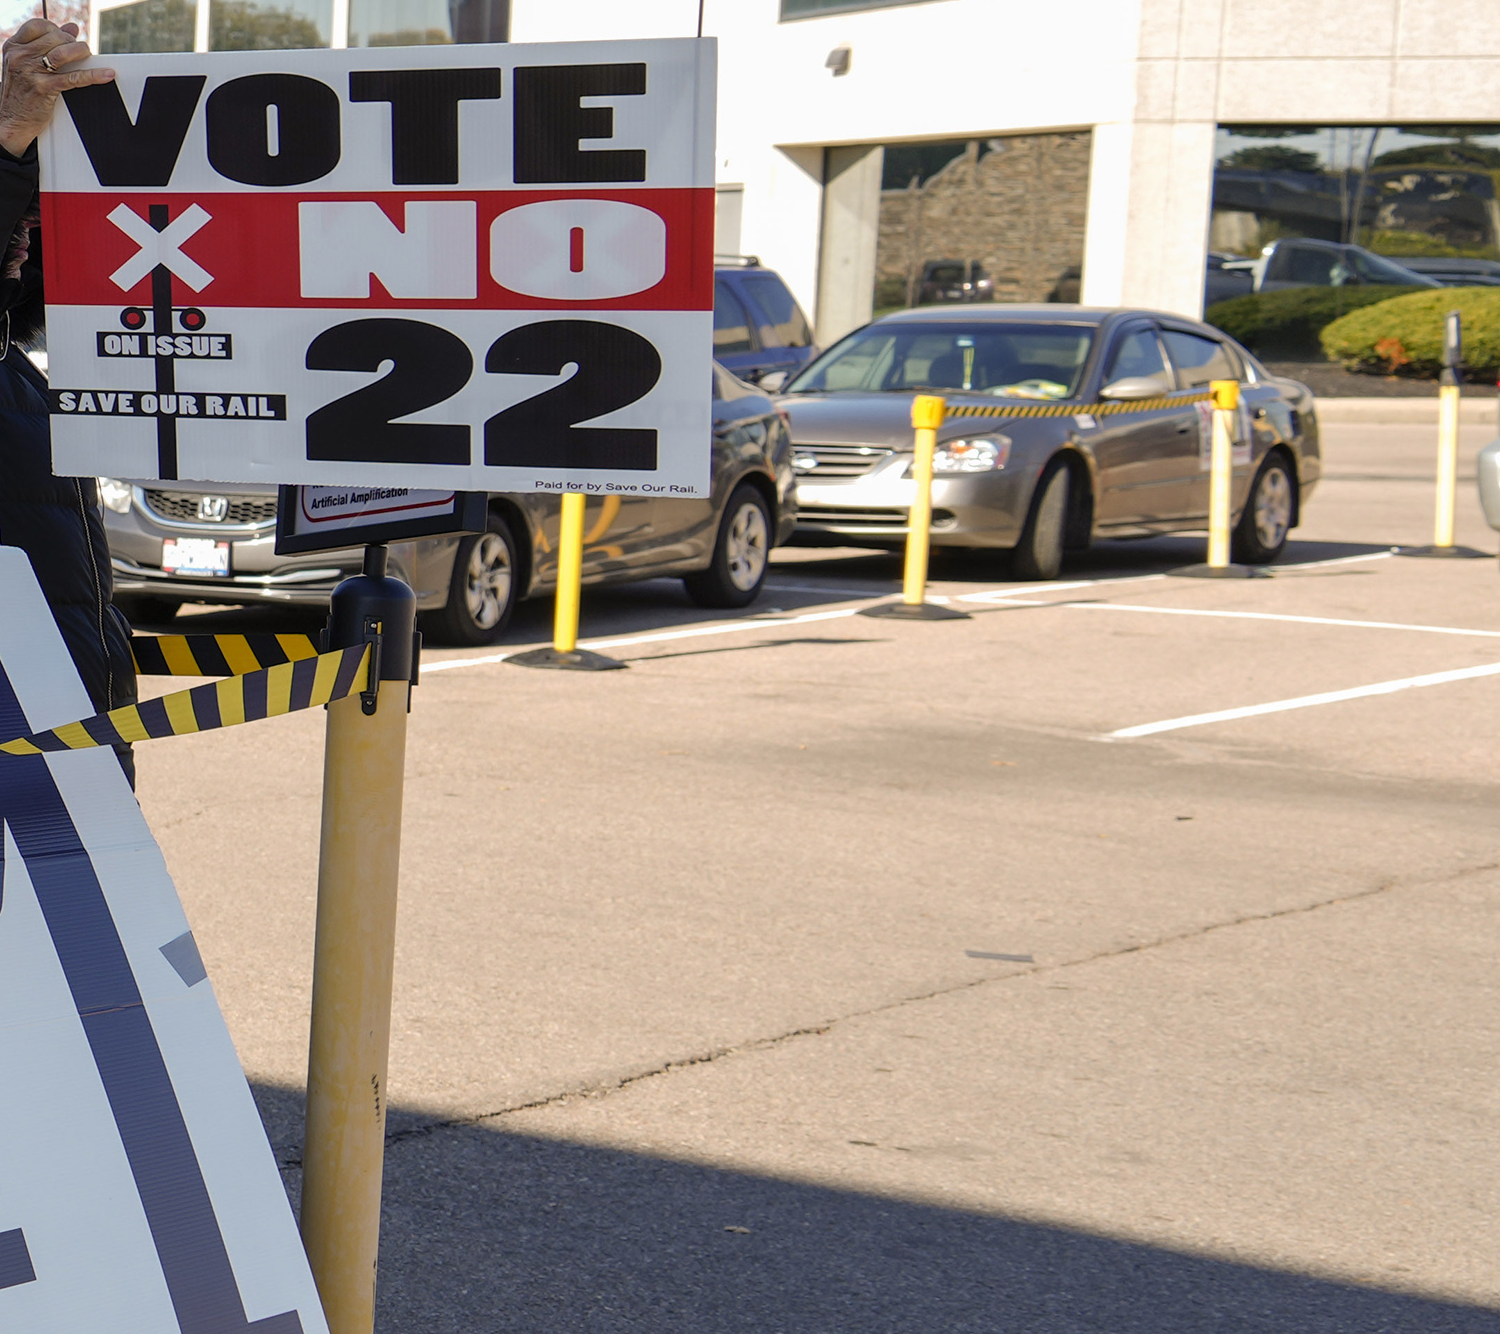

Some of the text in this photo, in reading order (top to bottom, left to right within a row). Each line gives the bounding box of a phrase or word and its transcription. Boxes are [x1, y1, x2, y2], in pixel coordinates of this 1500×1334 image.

[61, 61, 647, 188] VOTE
[299, 197, 667, 301] NO
[104, 334, 227, 357] ON ISSUE
[58, 390, 275, 418] SAVE OUR RAIL
[304, 316, 661, 472] 22
[311, 487, 408, 510] Artificial Amplification
[535, 480, 698, 495] Paid for by Save Our Rail.
